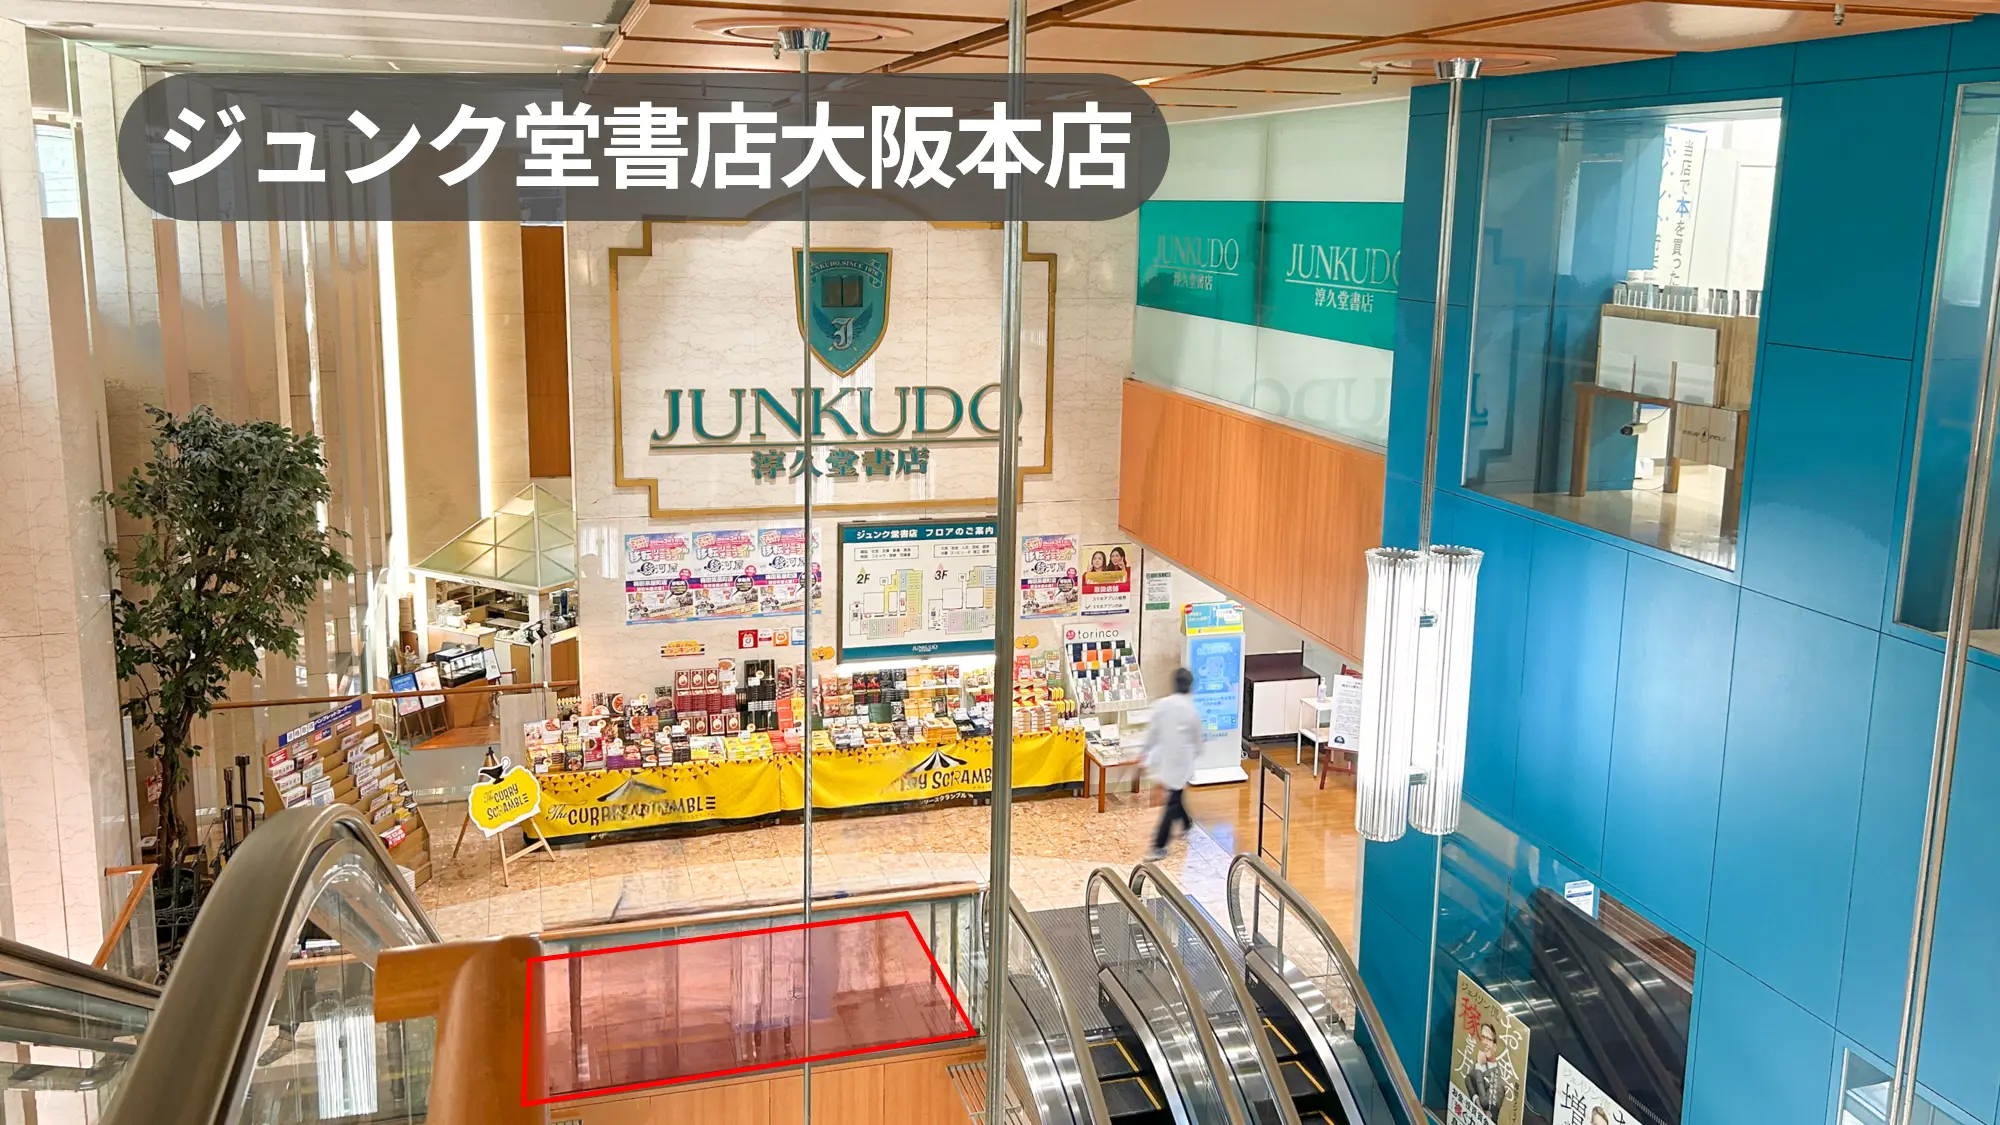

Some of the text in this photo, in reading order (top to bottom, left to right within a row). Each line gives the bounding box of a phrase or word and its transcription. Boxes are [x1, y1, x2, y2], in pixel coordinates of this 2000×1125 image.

[1154, 235, 1239, 270] JUNKUDO
[1315, 288, 1374, 313] 淳久堂書店
[650, 383, 1022, 441] JUNKUDO
[751, 446, 930, 479] 淳久堂書店
[856, 526, 994, 540] ジュンク堂書店 フロアのご案内
[856, 573, 870, 584] 2F
[934, 570, 948, 580] 3F
[1077, 628, 1119, 638] torinco
[494, 783, 519, 802] CURRY
[487, 793, 529, 820] SCRAMBLE
[546, 803, 567, 821] The
